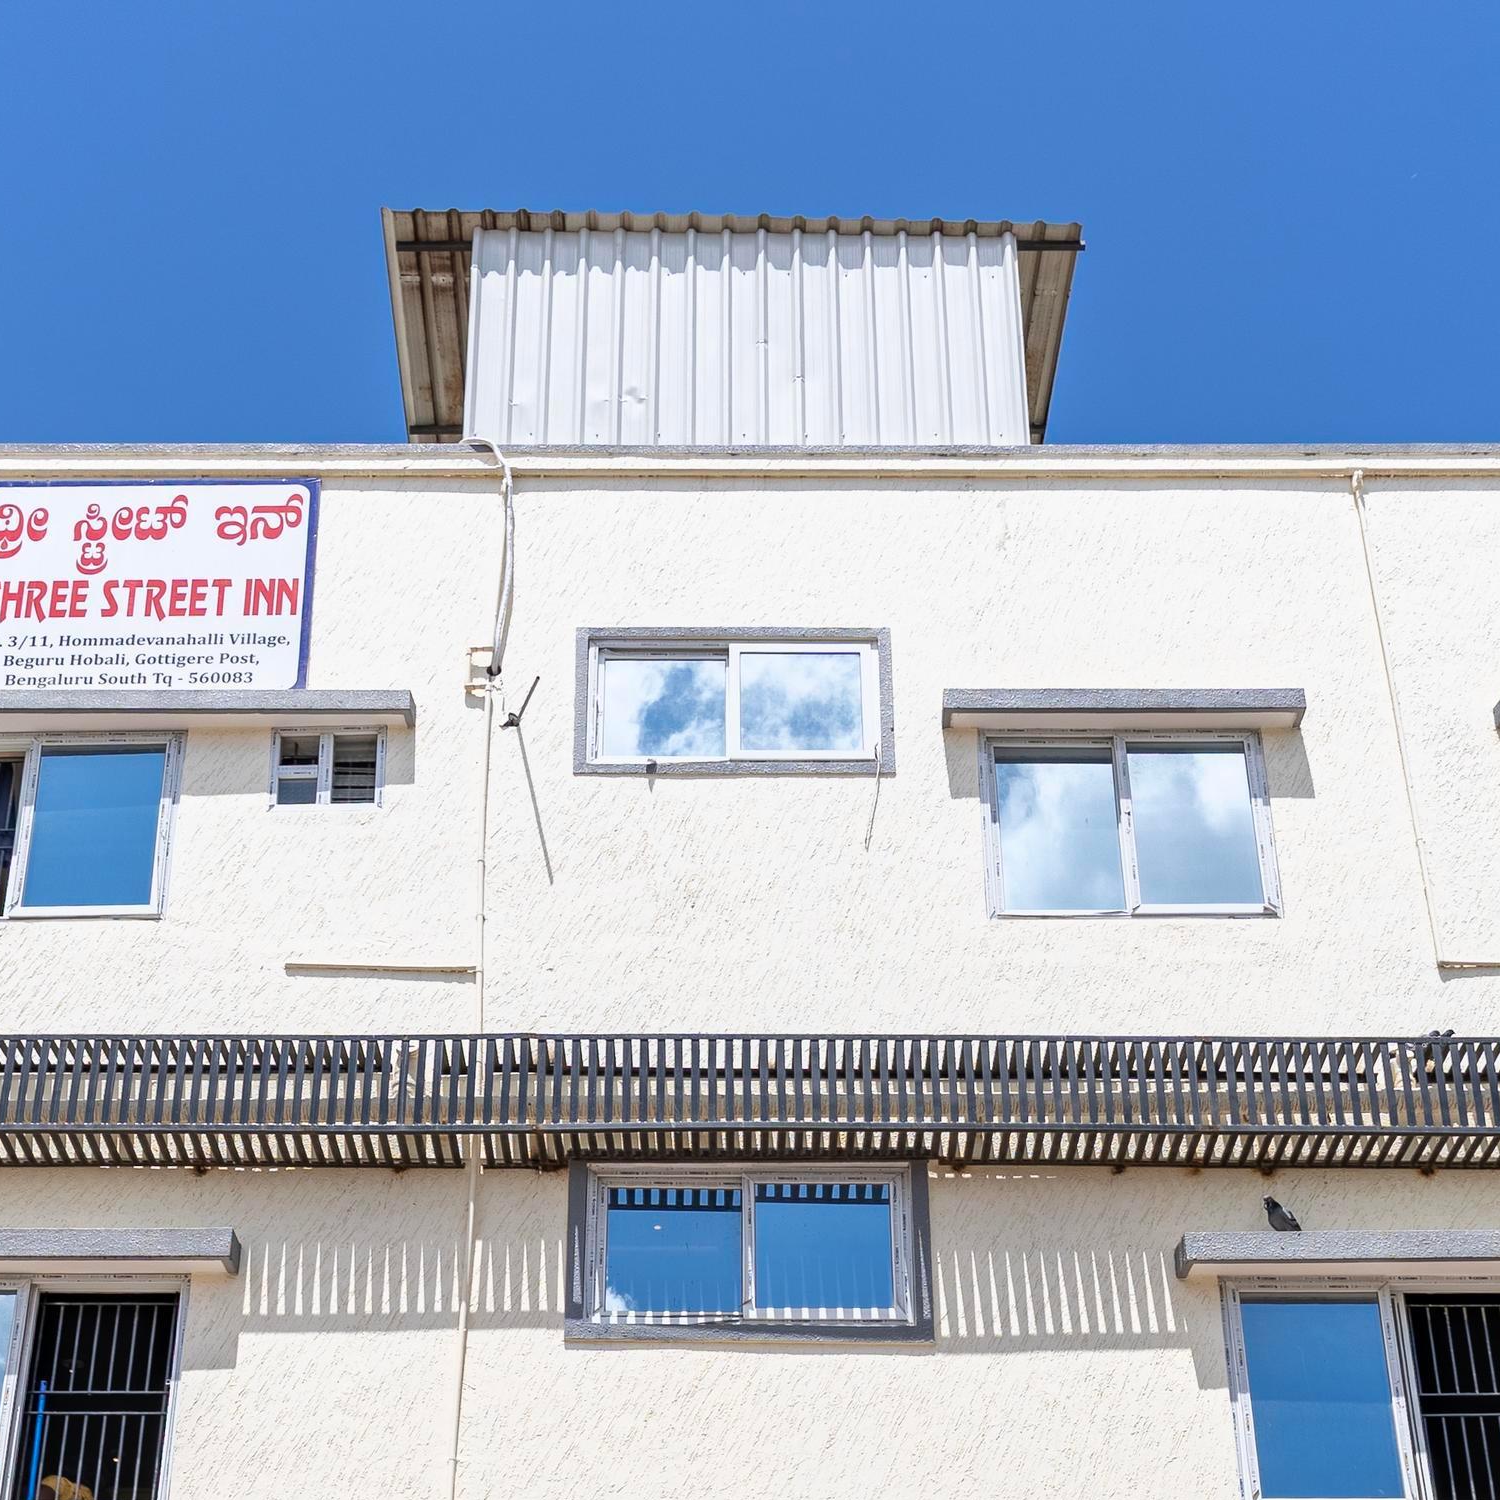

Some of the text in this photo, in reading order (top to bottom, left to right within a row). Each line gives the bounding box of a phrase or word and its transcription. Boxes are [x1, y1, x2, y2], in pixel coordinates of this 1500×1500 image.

[214, 492, 304, 546] ಇನ್
[100, 578, 233, 622] STREET
[242, 577, 299, 617] INN
[7, 635, 54, 650] 3/11,
[58, 633, 224, 647] Hommadevanahalli
[229, 632, 290, 648] Village,
[3, 652, 260, 669] Beguru Hobali, Gottigere Post,
[5, 674, 93, 689] Bengaluru
[97, 672, 146, 685] South
[152, 672, 173, 687] Tq
[188, 671, 253, 684] 560083
